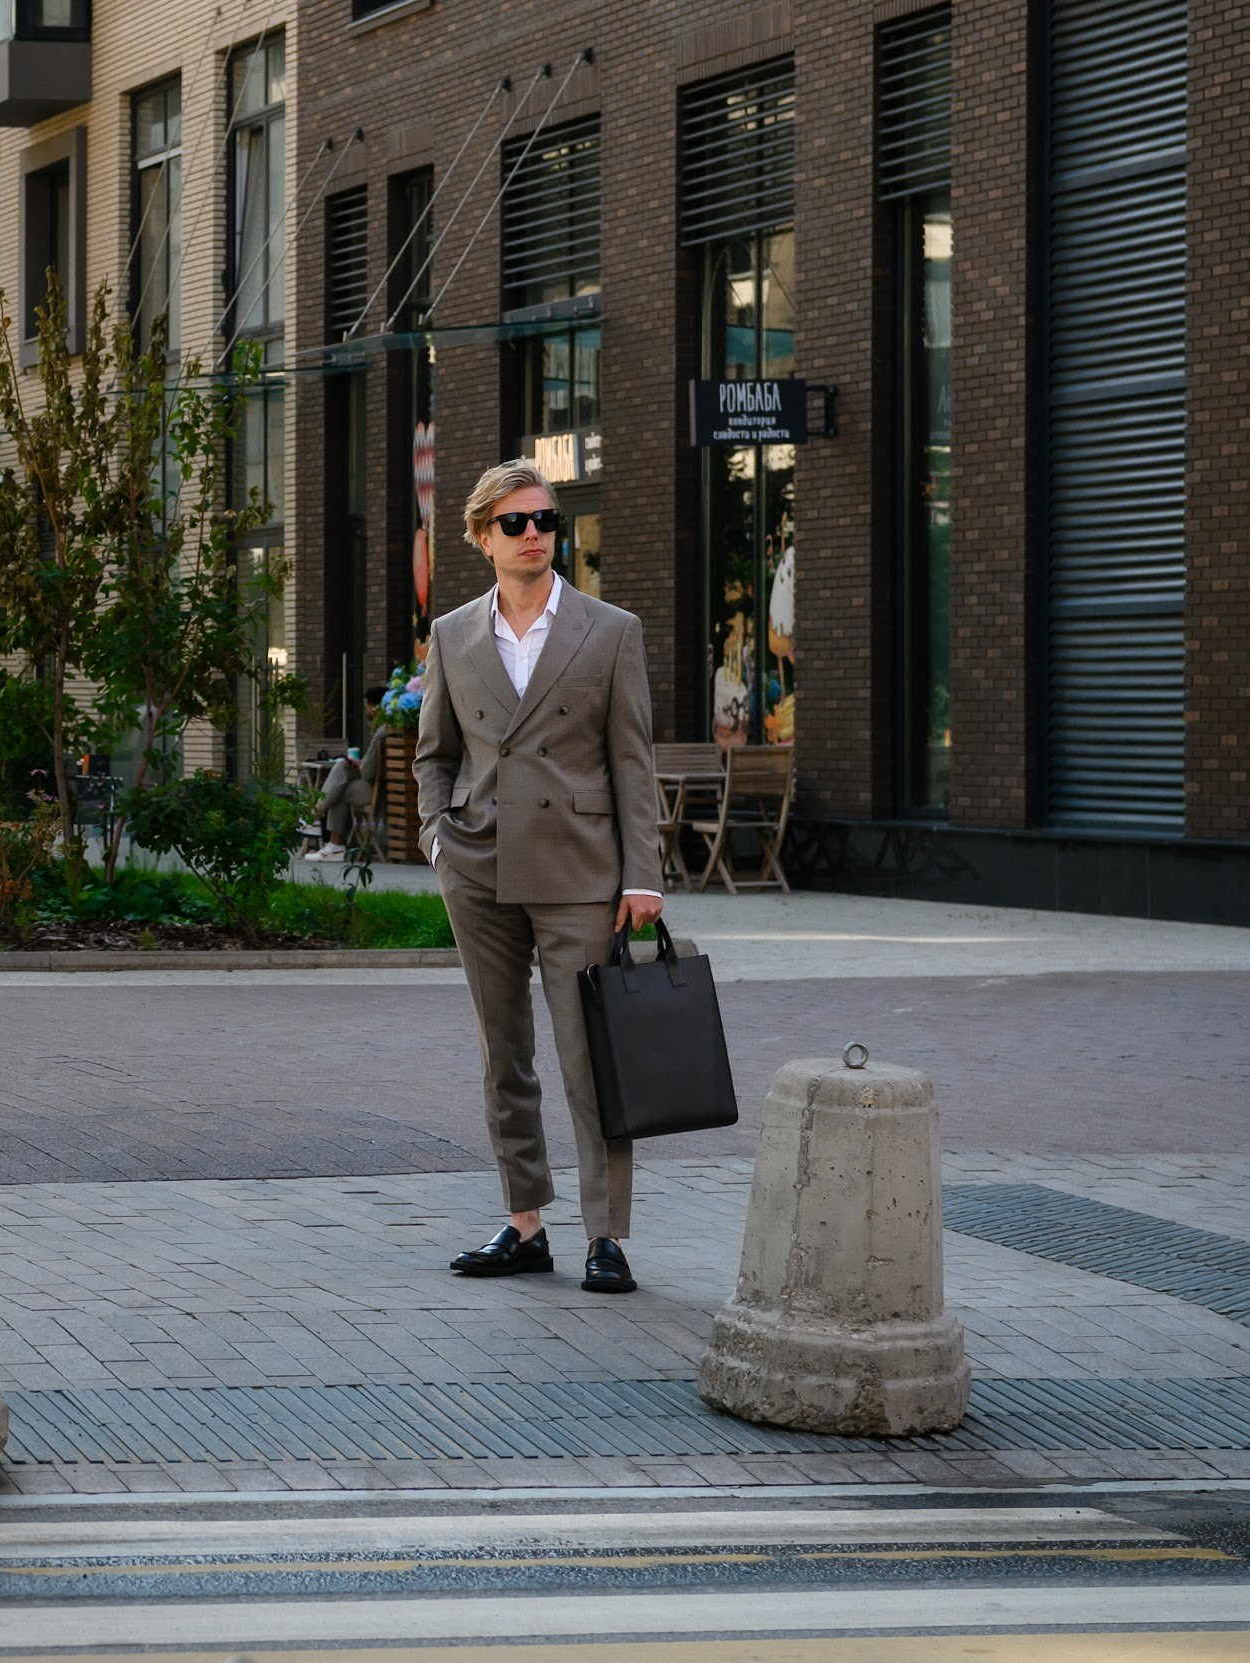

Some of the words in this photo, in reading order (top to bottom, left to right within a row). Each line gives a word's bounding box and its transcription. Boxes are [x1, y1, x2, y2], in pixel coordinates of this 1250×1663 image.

[719, 382, 782, 413] РОМБАБА
[712, 427, 750, 440] сладости
[751, 430, 758, 440] и
[758, 427, 790, 442] радости
